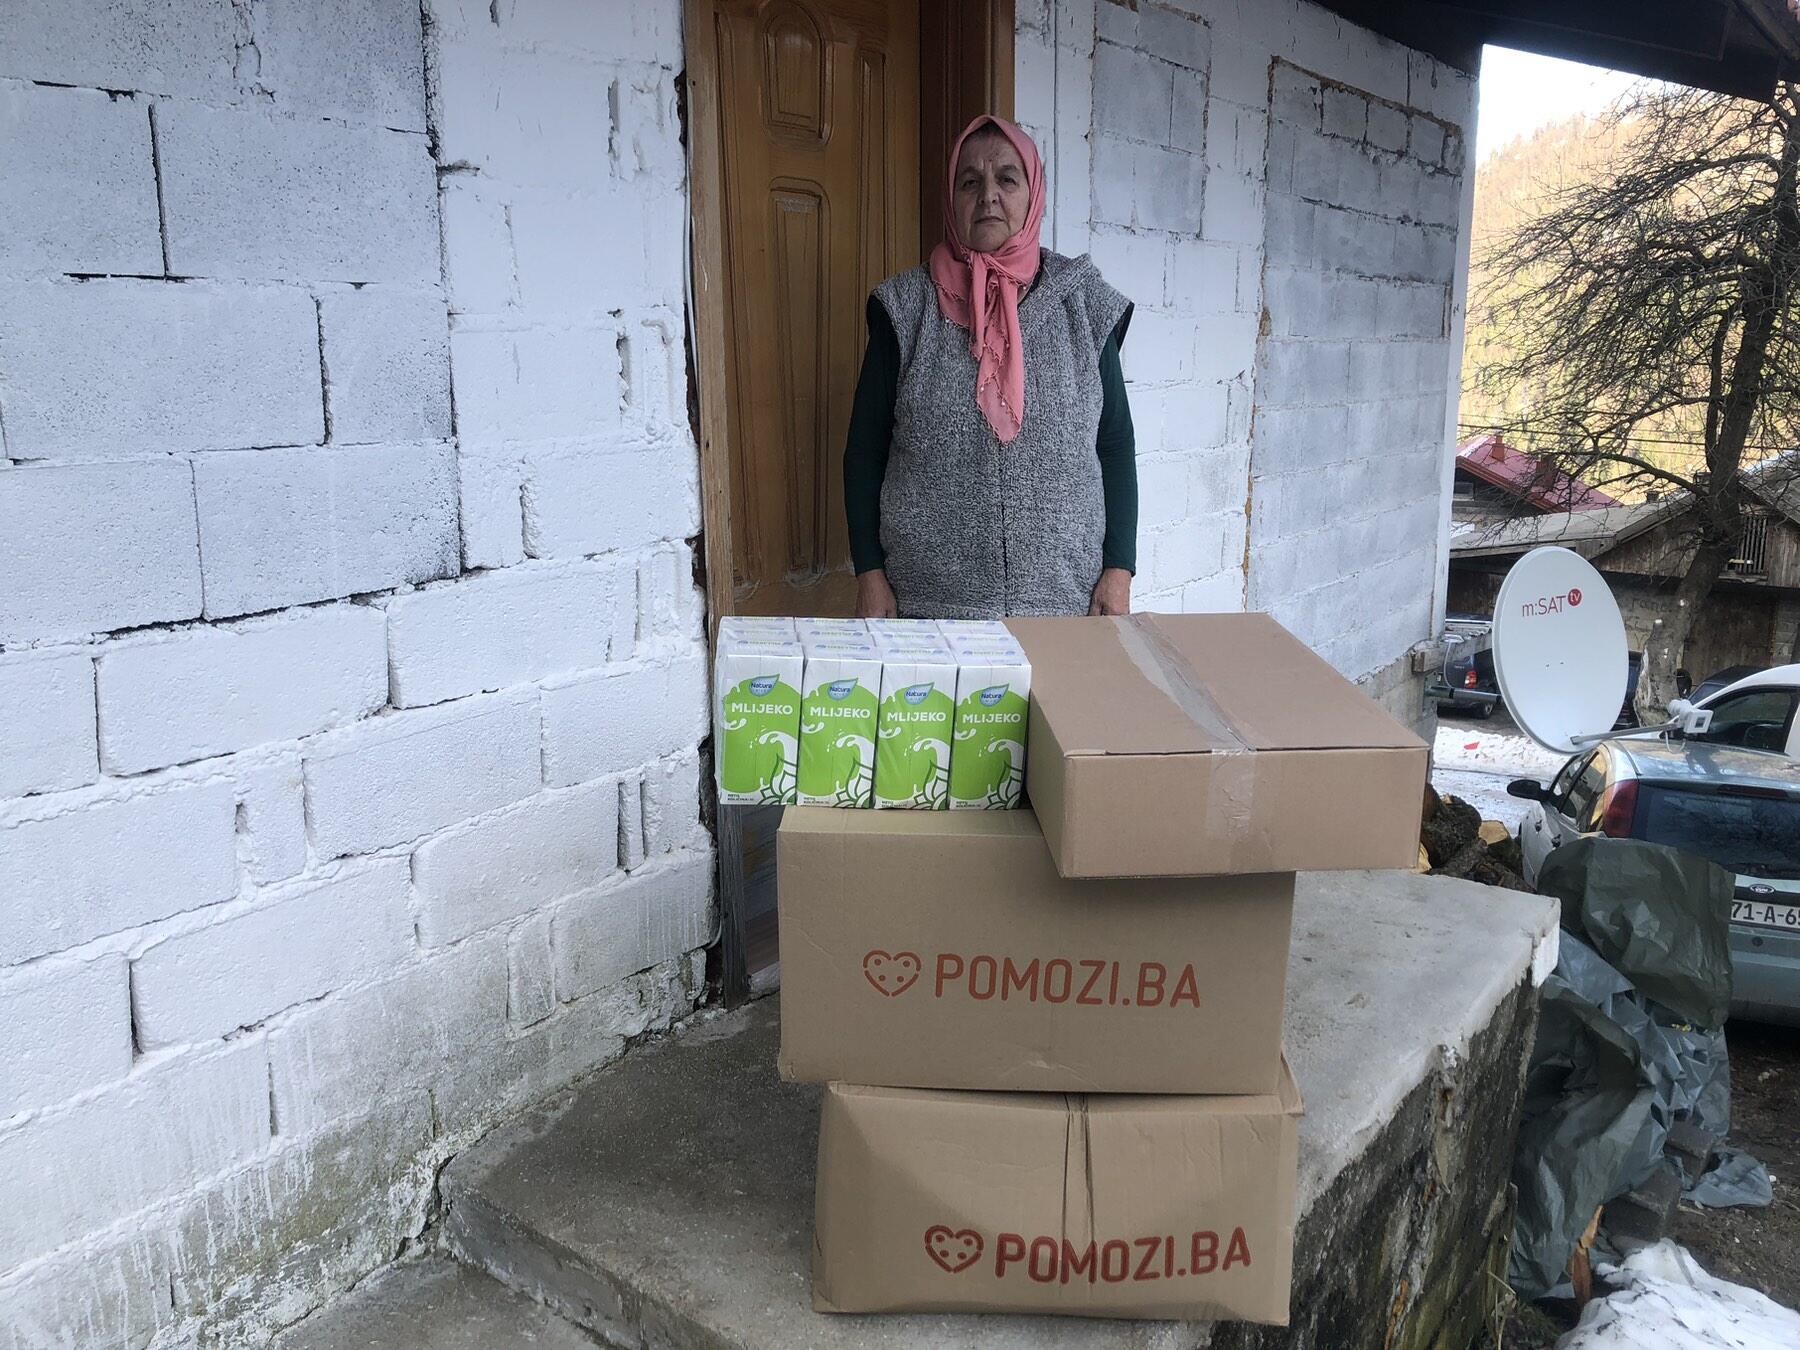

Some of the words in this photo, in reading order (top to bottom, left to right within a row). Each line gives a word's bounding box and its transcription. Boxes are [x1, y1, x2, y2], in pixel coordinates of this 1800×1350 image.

[1522, 595, 1566, 617] m:SAT
[731, 702, 793, 715] MLIJEKO
[810, 706, 871, 719] MLIJEKO
[887, 711, 946, 722] MLIJEKO
[962, 713, 1021, 724] MLIJEKO
[1732, 901, 1800, 926] 71-A-6
[935, 953, 1201, 1008] POMOZI.BA
[995, 1226, 1251, 1284] POMOZI.BA
